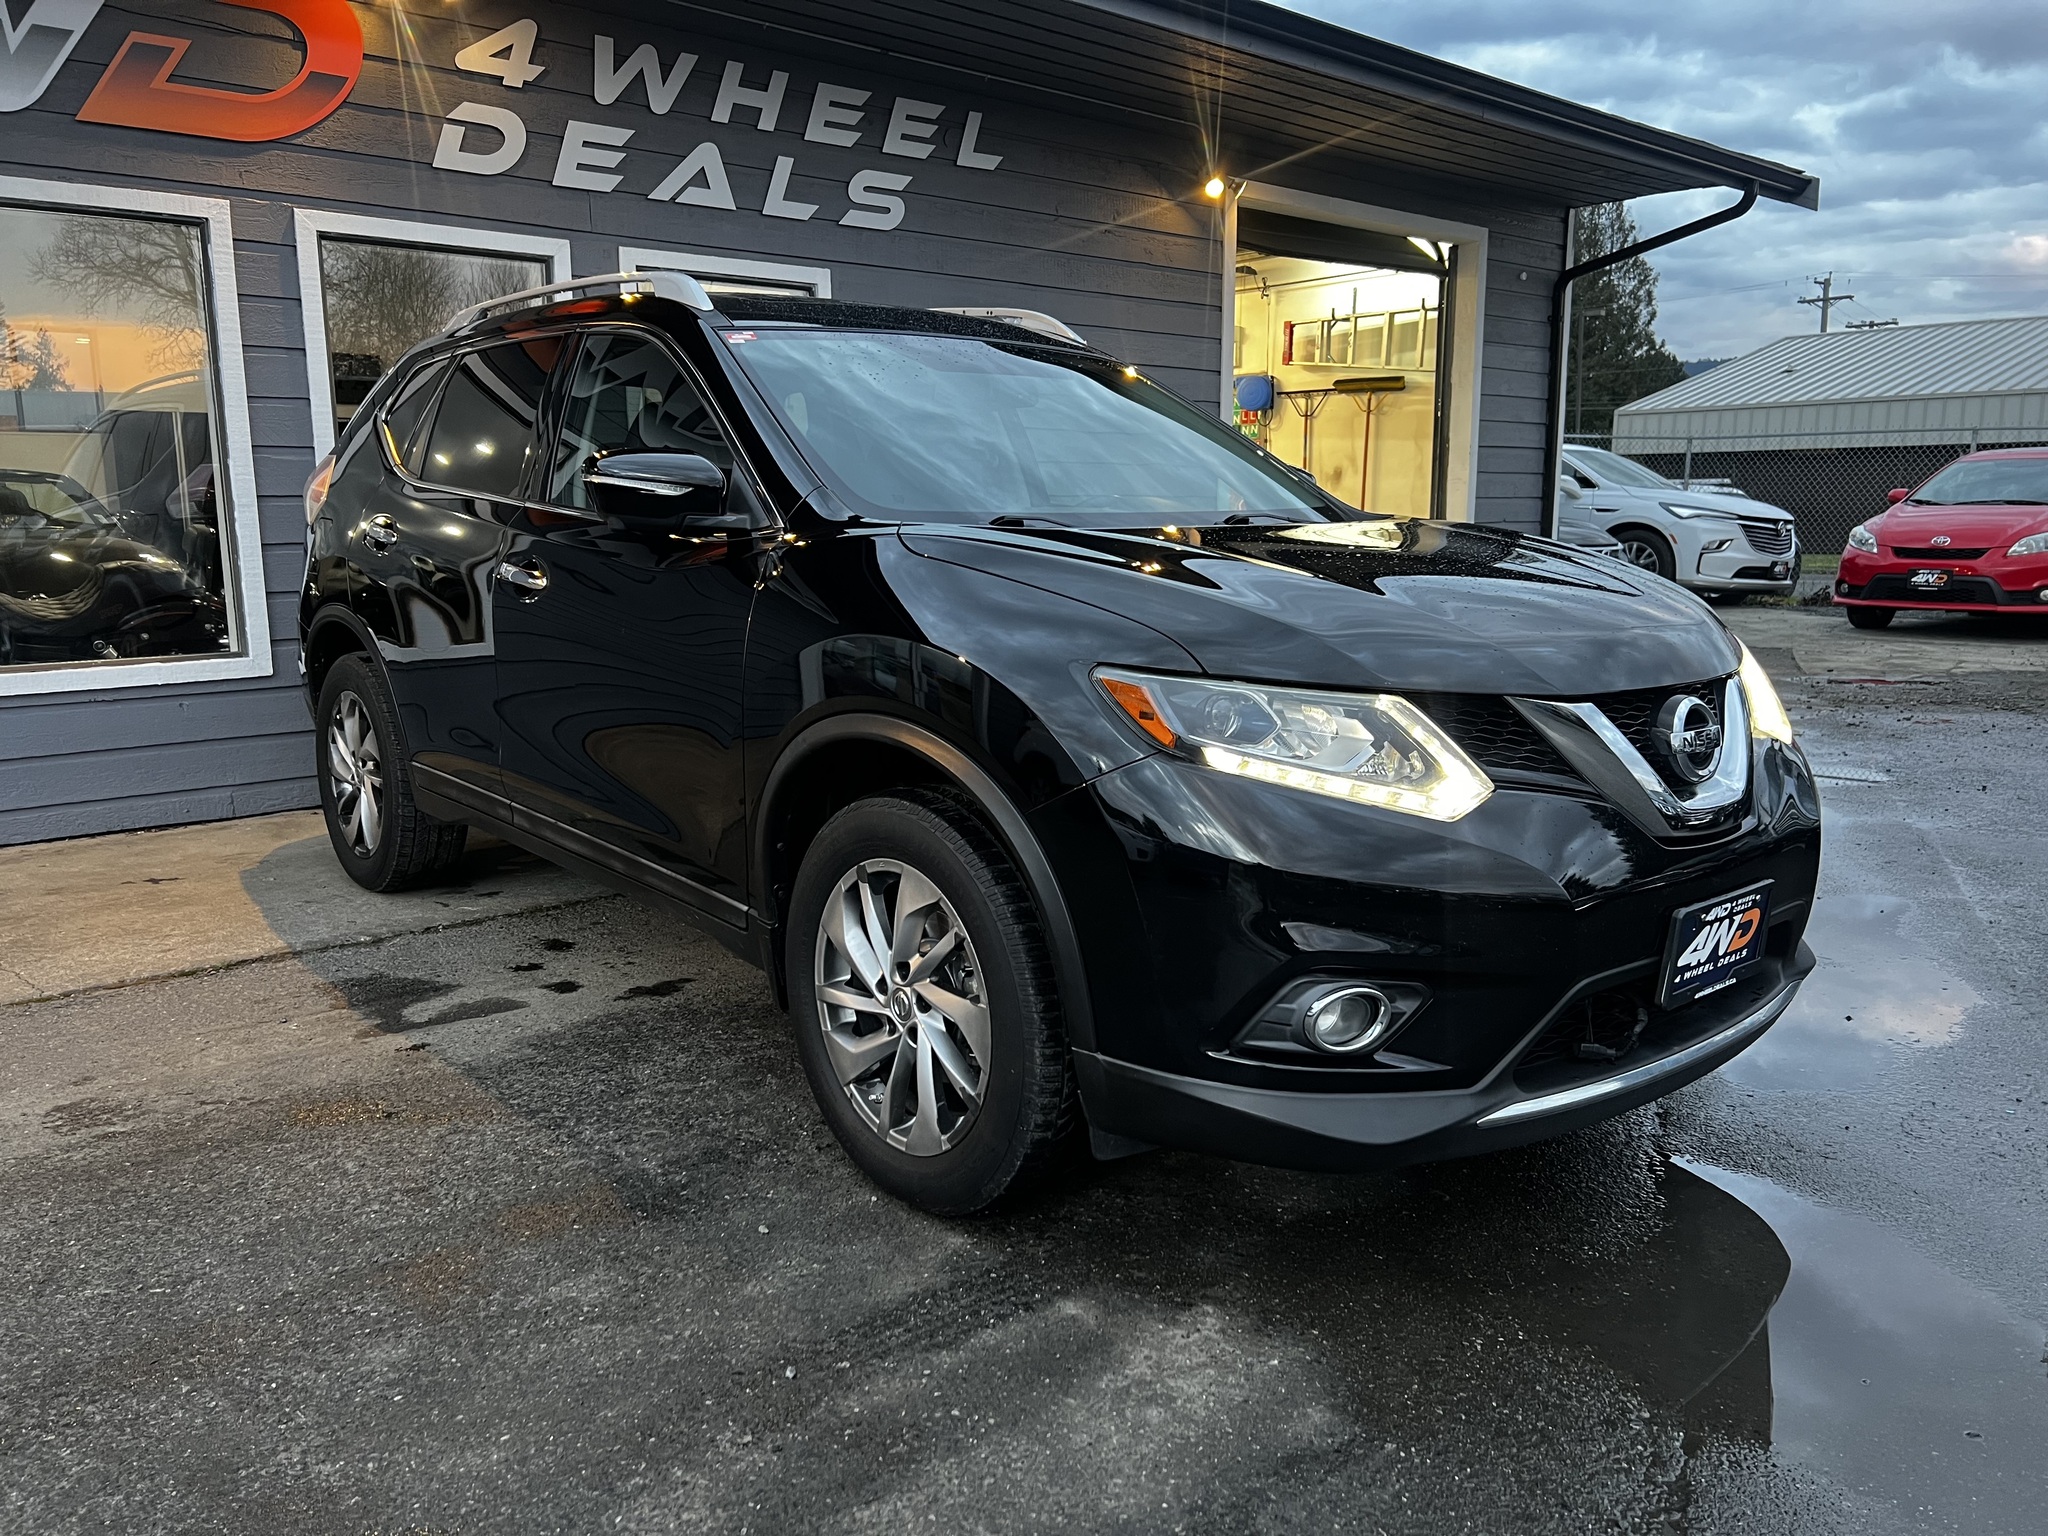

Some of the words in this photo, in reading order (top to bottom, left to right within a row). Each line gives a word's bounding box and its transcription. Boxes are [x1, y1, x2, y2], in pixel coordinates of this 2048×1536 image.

[454, 19, 546, 88] 4
[594, 34, 1004, 171] WHEEL
[432, 101, 914, 231] DEALS
[1674, 974, 1681, 983] 4
[1683, 962, 1715, 981] WHEEL
[1717, 948, 1748, 968] DEALS
[1677, 907, 1761, 967] 4WD
